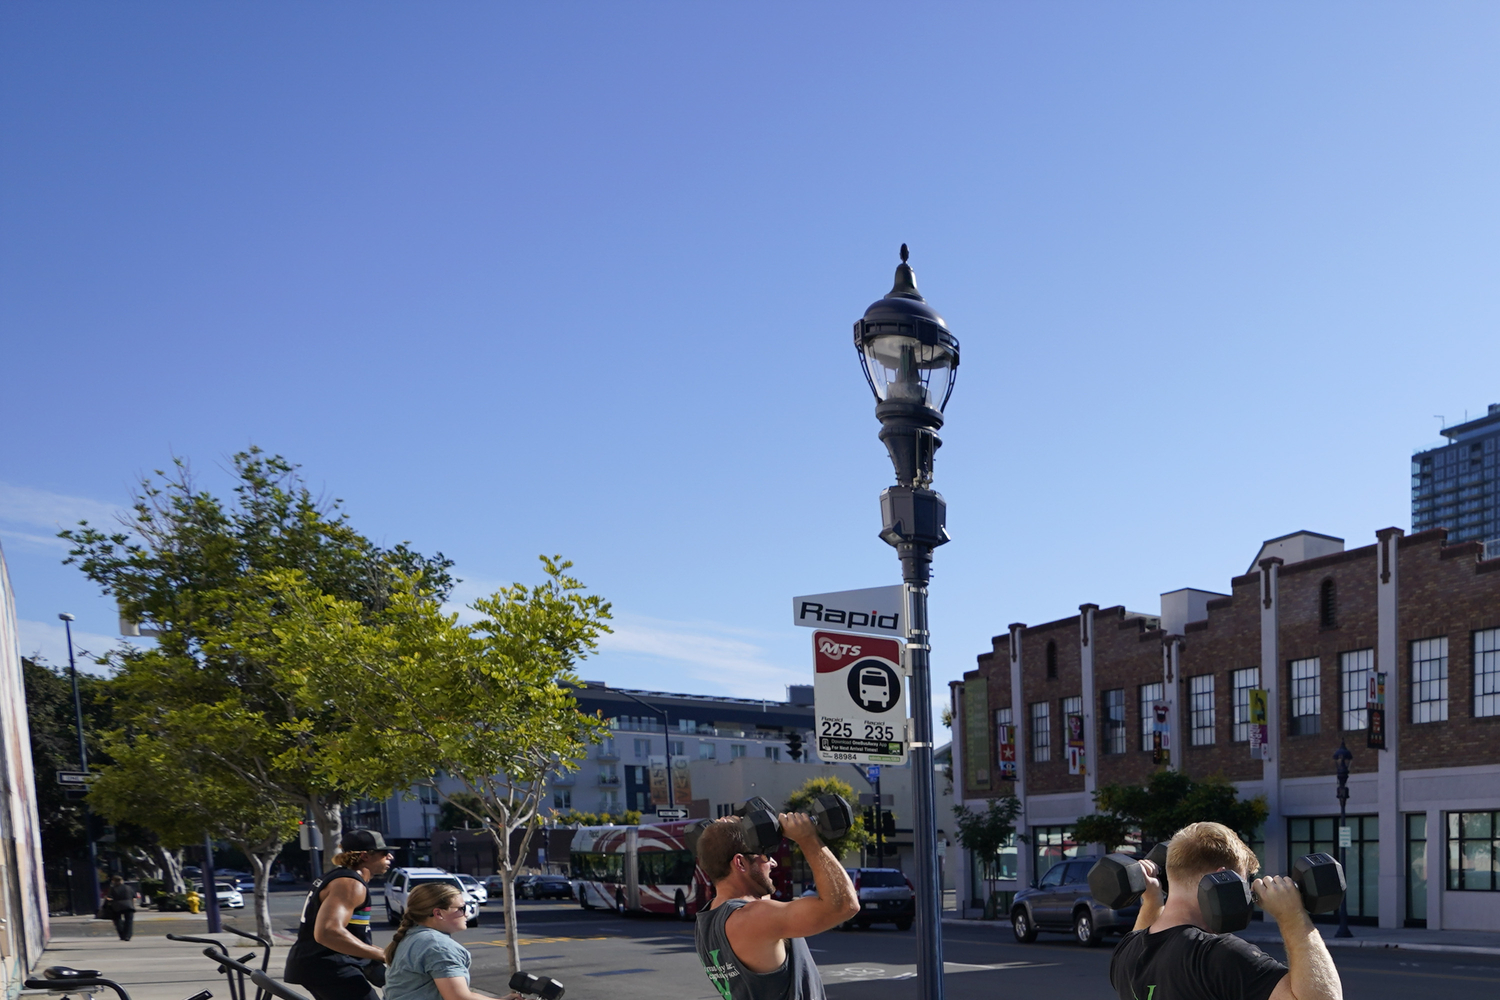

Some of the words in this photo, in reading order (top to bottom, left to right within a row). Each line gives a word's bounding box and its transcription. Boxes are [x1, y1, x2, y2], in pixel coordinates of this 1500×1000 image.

[800, 601, 899, 630] Rapid
[819, 641, 862, 657] MTS
[822, 721, 853, 738] 225
[864, 725, 894, 741] 235
